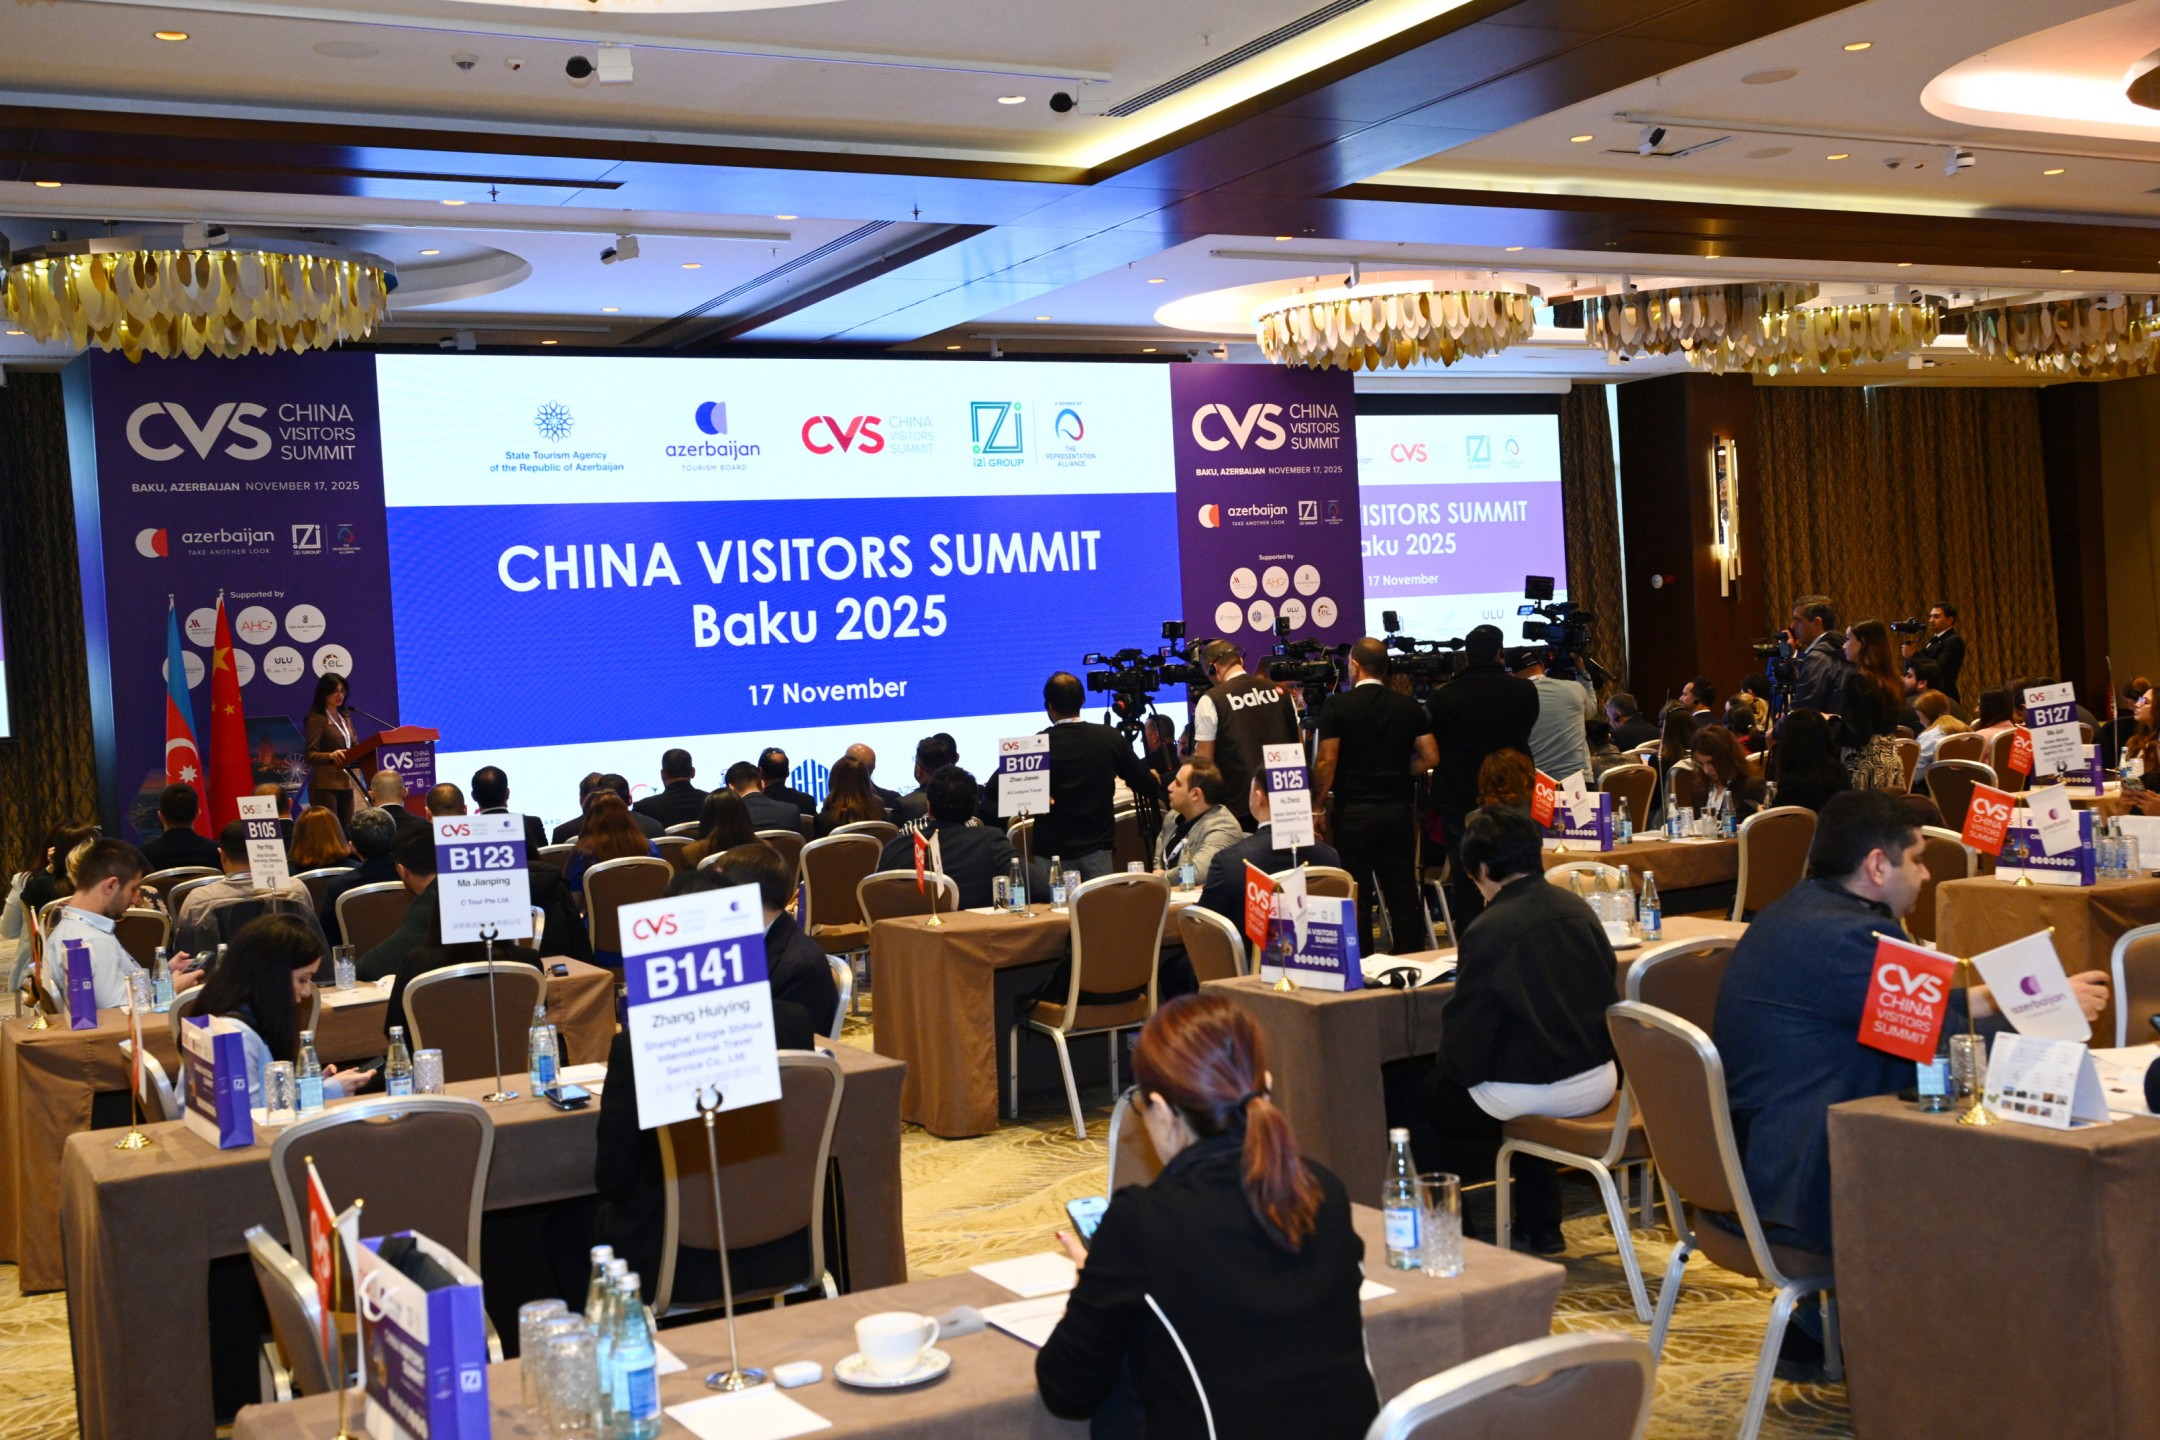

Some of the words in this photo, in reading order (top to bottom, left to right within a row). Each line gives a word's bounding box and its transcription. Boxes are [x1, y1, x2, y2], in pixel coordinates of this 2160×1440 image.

[279, 403, 353, 422] CHINA
[1290, 404, 1339, 419] CHINA
[889, 416, 933, 429] CHINA
[1192, 403, 1287, 451] CVS
[1290, 422, 1340, 434] VISITORS
[126, 402, 272, 461] CVS
[279, 427, 356, 441] VISITORS
[801, 415, 885, 454] CVS
[889, 431, 934, 441] VISITORS
[665, 440, 761, 461] azerbaijan
[890, 443, 934, 454] SUMMIT
[1291, 437, 1340, 450] SUMMIT
[281, 445, 356, 460] SUMMIT
[505, 451, 530, 460] State
[533, 450, 571, 460] Tourism
[573, 450, 607, 462] Agency
[1390, 443, 1428, 463] CVS
[489, 463, 499, 472] of
[502, 463, 517, 472] the
[519, 463, 560, 473] Republic
[563, 463, 573, 472] of
[575, 462, 625, 473] Azerbaijan
[681, 464, 717, 472] TOURISM
[719, 463, 748, 471] BOARD
[988, 458, 1024, 468] GROUP
[1196, 468, 1219, 476] BAKU,
[1220, 467, 1266, 476] AZERBAIJAN
[1268, 466, 1311, 475] NOVEMBER
[1323, 465, 1343, 474] 2025
[132, 483, 168, 493] BAKU,
[170, 482, 240, 493] AZERBAIJAN
[245, 481, 311, 492] NOVEMBER
[314, 481, 328, 492] 17,
[331, 481, 360, 491] 2025
[1227, 504, 1288, 519] azerbaijan
[1360, 503, 1441, 527] ISITORS
[1447, 500, 1528, 524] SUMMIT
[181, 528, 275, 546] azerbaijan
[1361, 534, 1399, 558] aku
[1406, 532, 1457, 556] 2025
[498, 541, 682, 592] CHINA
[697, 534, 914, 585] VISITORS
[929, 530, 1101, 575] SUMMIT
[1258, 553, 1286, 561] Supported
[1367, 576, 1380, 587] 17
[1383, 573, 1439, 586] November
[230, 590, 273, 600] Supported
[274, 589, 285, 598] by
[692, 601, 818, 648] Baku
[835, 594, 948, 641] 2025
[1482, 609, 1504, 620] ULU
[274, 656, 293, 665] ULU
[748, 684, 775, 706] 17
[783, 677, 908, 706] November
[1226, 687, 1280, 711] baku
[2029, 692, 2046, 703] CVS
[2034, 705, 2071, 726] B127
[1003, 741, 1020, 751] CVS
[383, 751, 414, 770] CVS
[1006, 755, 1043, 772] B107
[1267, 751, 1281, 763] CVS
[1272, 770, 1304, 790] B125
[1536, 783, 1554, 801] CVS
[242, 805, 255, 815] CVS
[1972, 798, 2010, 820] CVS
[247, 821, 276, 838] B105
[441, 823, 471, 837] CVS
[1973, 814, 2003, 830] CHINA
[449, 845, 515, 871] B123
[457, 879, 471, 888] Ma
[473, 876, 510, 888] Jianping
[1247, 881, 1270, 911] CVS
[633, 913, 678, 940] CVS
[645, 943, 744, 999] B141
[1877, 963, 1943, 1004] CVS
[1879, 991, 1933, 1020] CHINA
[2011, 992, 2067, 1015] azerbaijan
[652, 1007, 695, 1029] Zhang
[699, 998, 750, 1020] Huiying
[1876, 1007, 1932, 1033] VISITORS
[1873, 1020, 1929, 1046] SUMMIT
[644, 1034, 692, 1053] Shanghai
[657, 1042, 721, 1064] International
[724, 1035, 753, 1049] Travel
[666, 1061, 703, 1077] Service
